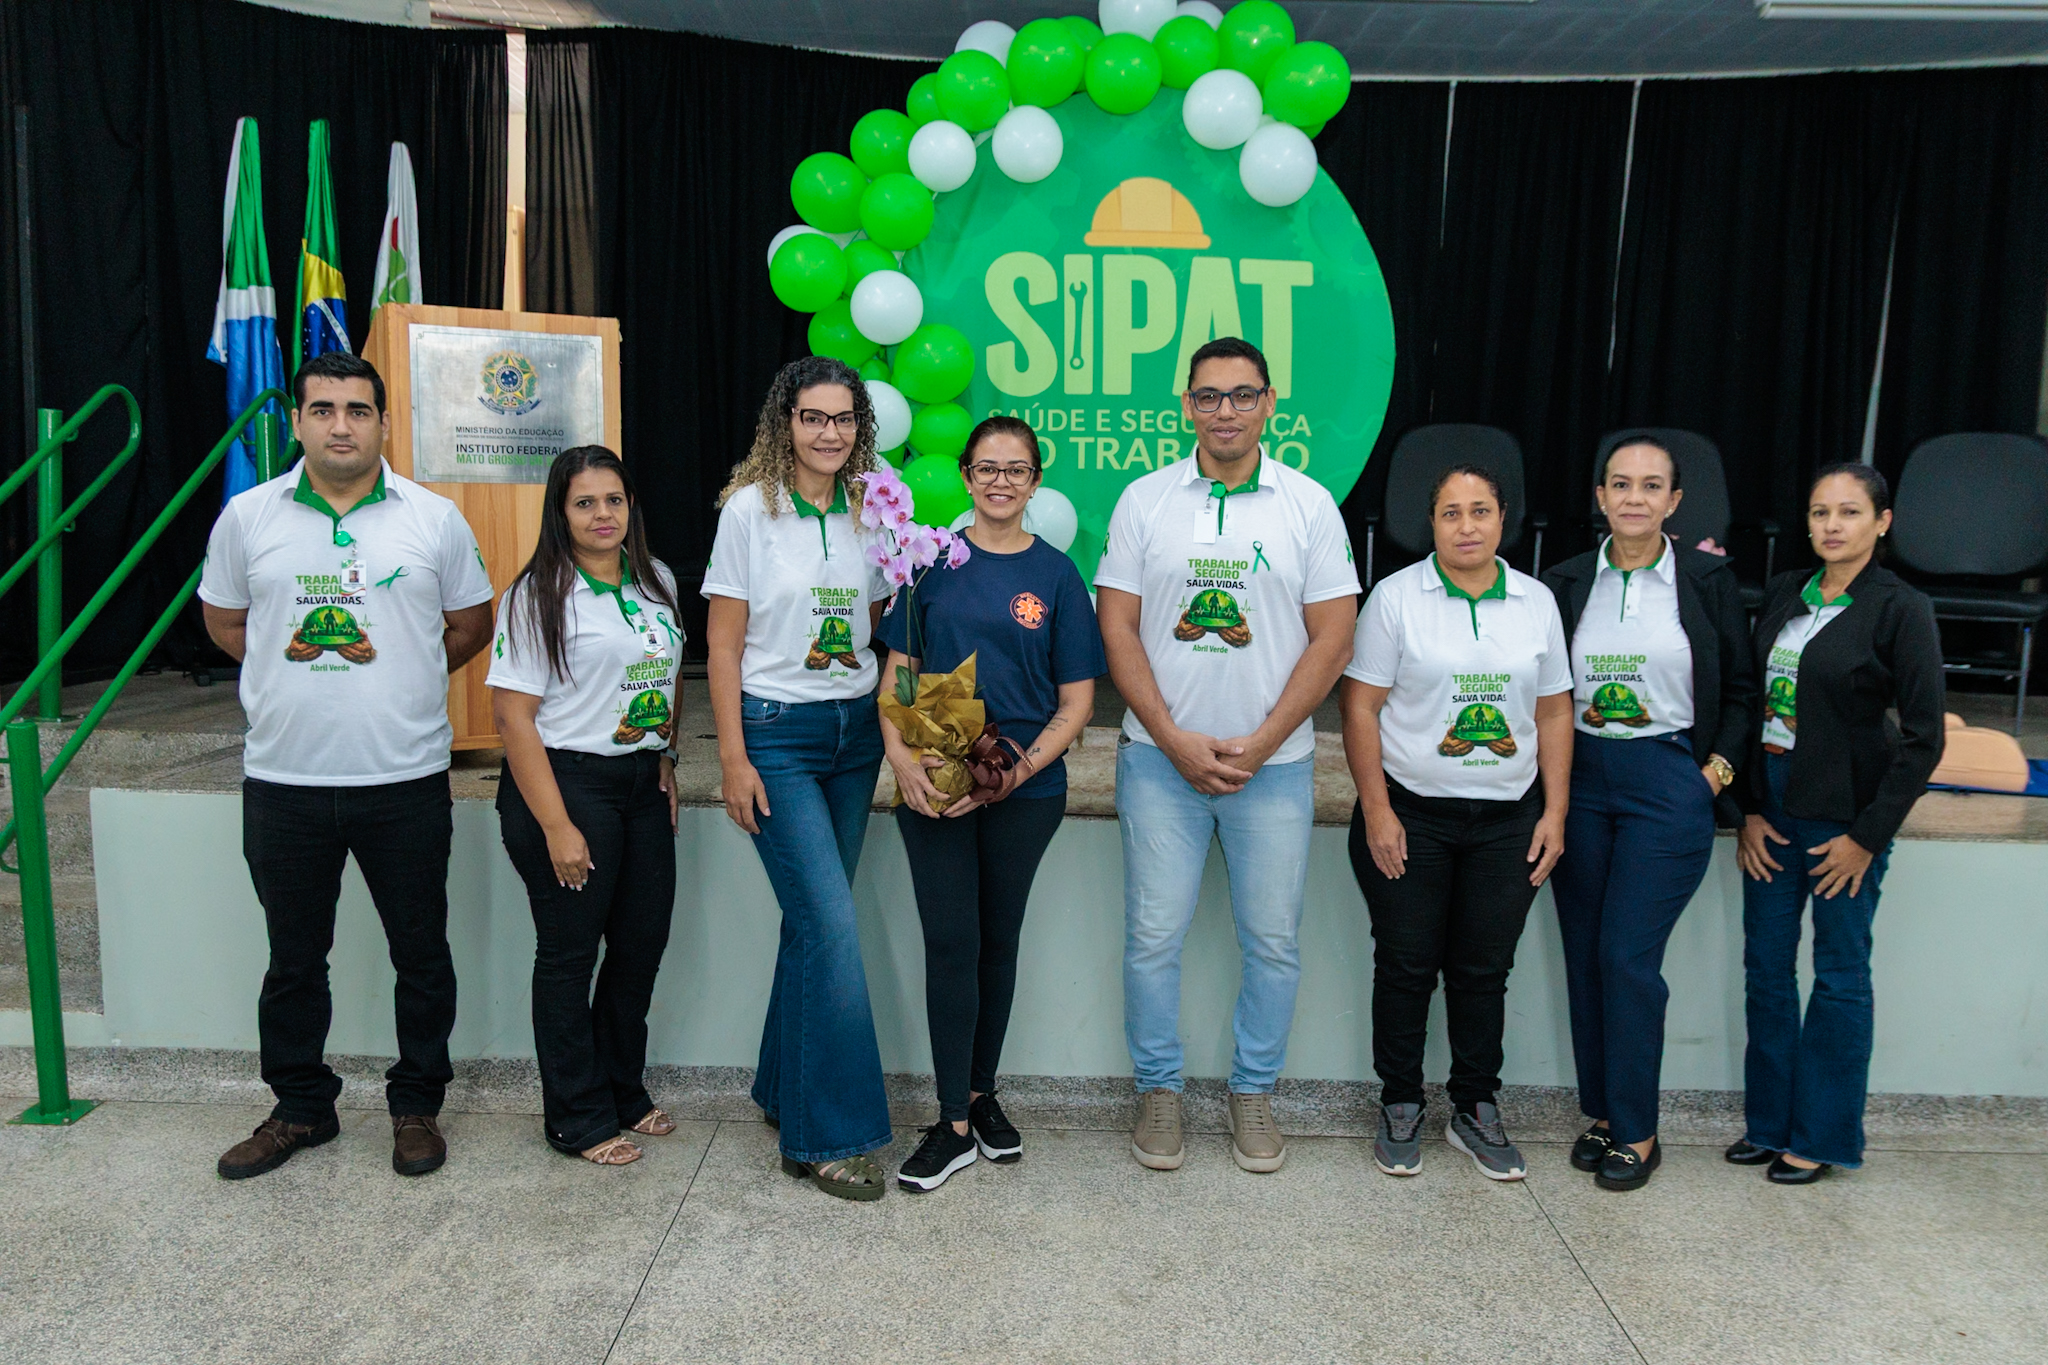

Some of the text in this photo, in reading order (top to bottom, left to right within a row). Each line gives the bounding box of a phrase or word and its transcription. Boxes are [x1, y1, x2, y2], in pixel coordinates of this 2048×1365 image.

[984, 251, 1314, 399] SIPAT
[1096, 409, 1111, 432] E
[456, 426, 503, 435] MINISTÉRIO
[519, 427, 564, 437] EDUCAÇÃO
[456, 443, 514, 455] INSTITUTO
[456, 454, 485, 465] MATO
[488, 454, 526, 466] GROSSO
[1187, 558, 1248, 570] TRABALHO
[1195, 568, 1240, 579] SEGURO
[1186, 579, 1247, 590] SALVA VIDAS.
[296, 596, 365, 605] SALVA VIDAS.
[819, 597, 853, 607] SEGURO
[1192, 644, 1228, 654] Abril Verde
[1585, 655, 1646, 664] TRABALHO
[310, 664, 350, 672] Abril Verde
[625, 658, 674, 675] TRABALHO
[1592, 664, 1638, 673] SEGURO
[628, 668, 668, 681] SEGURO
[1452, 674, 1511, 684] TRABALHO
[1585, 674, 1645, 682] SALVA VIDAS.
[621, 681, 650, 692] SALVA
[1460, 683, 1503, 693] SEGURO
[1452, 694, 1479, 703] SALVA
